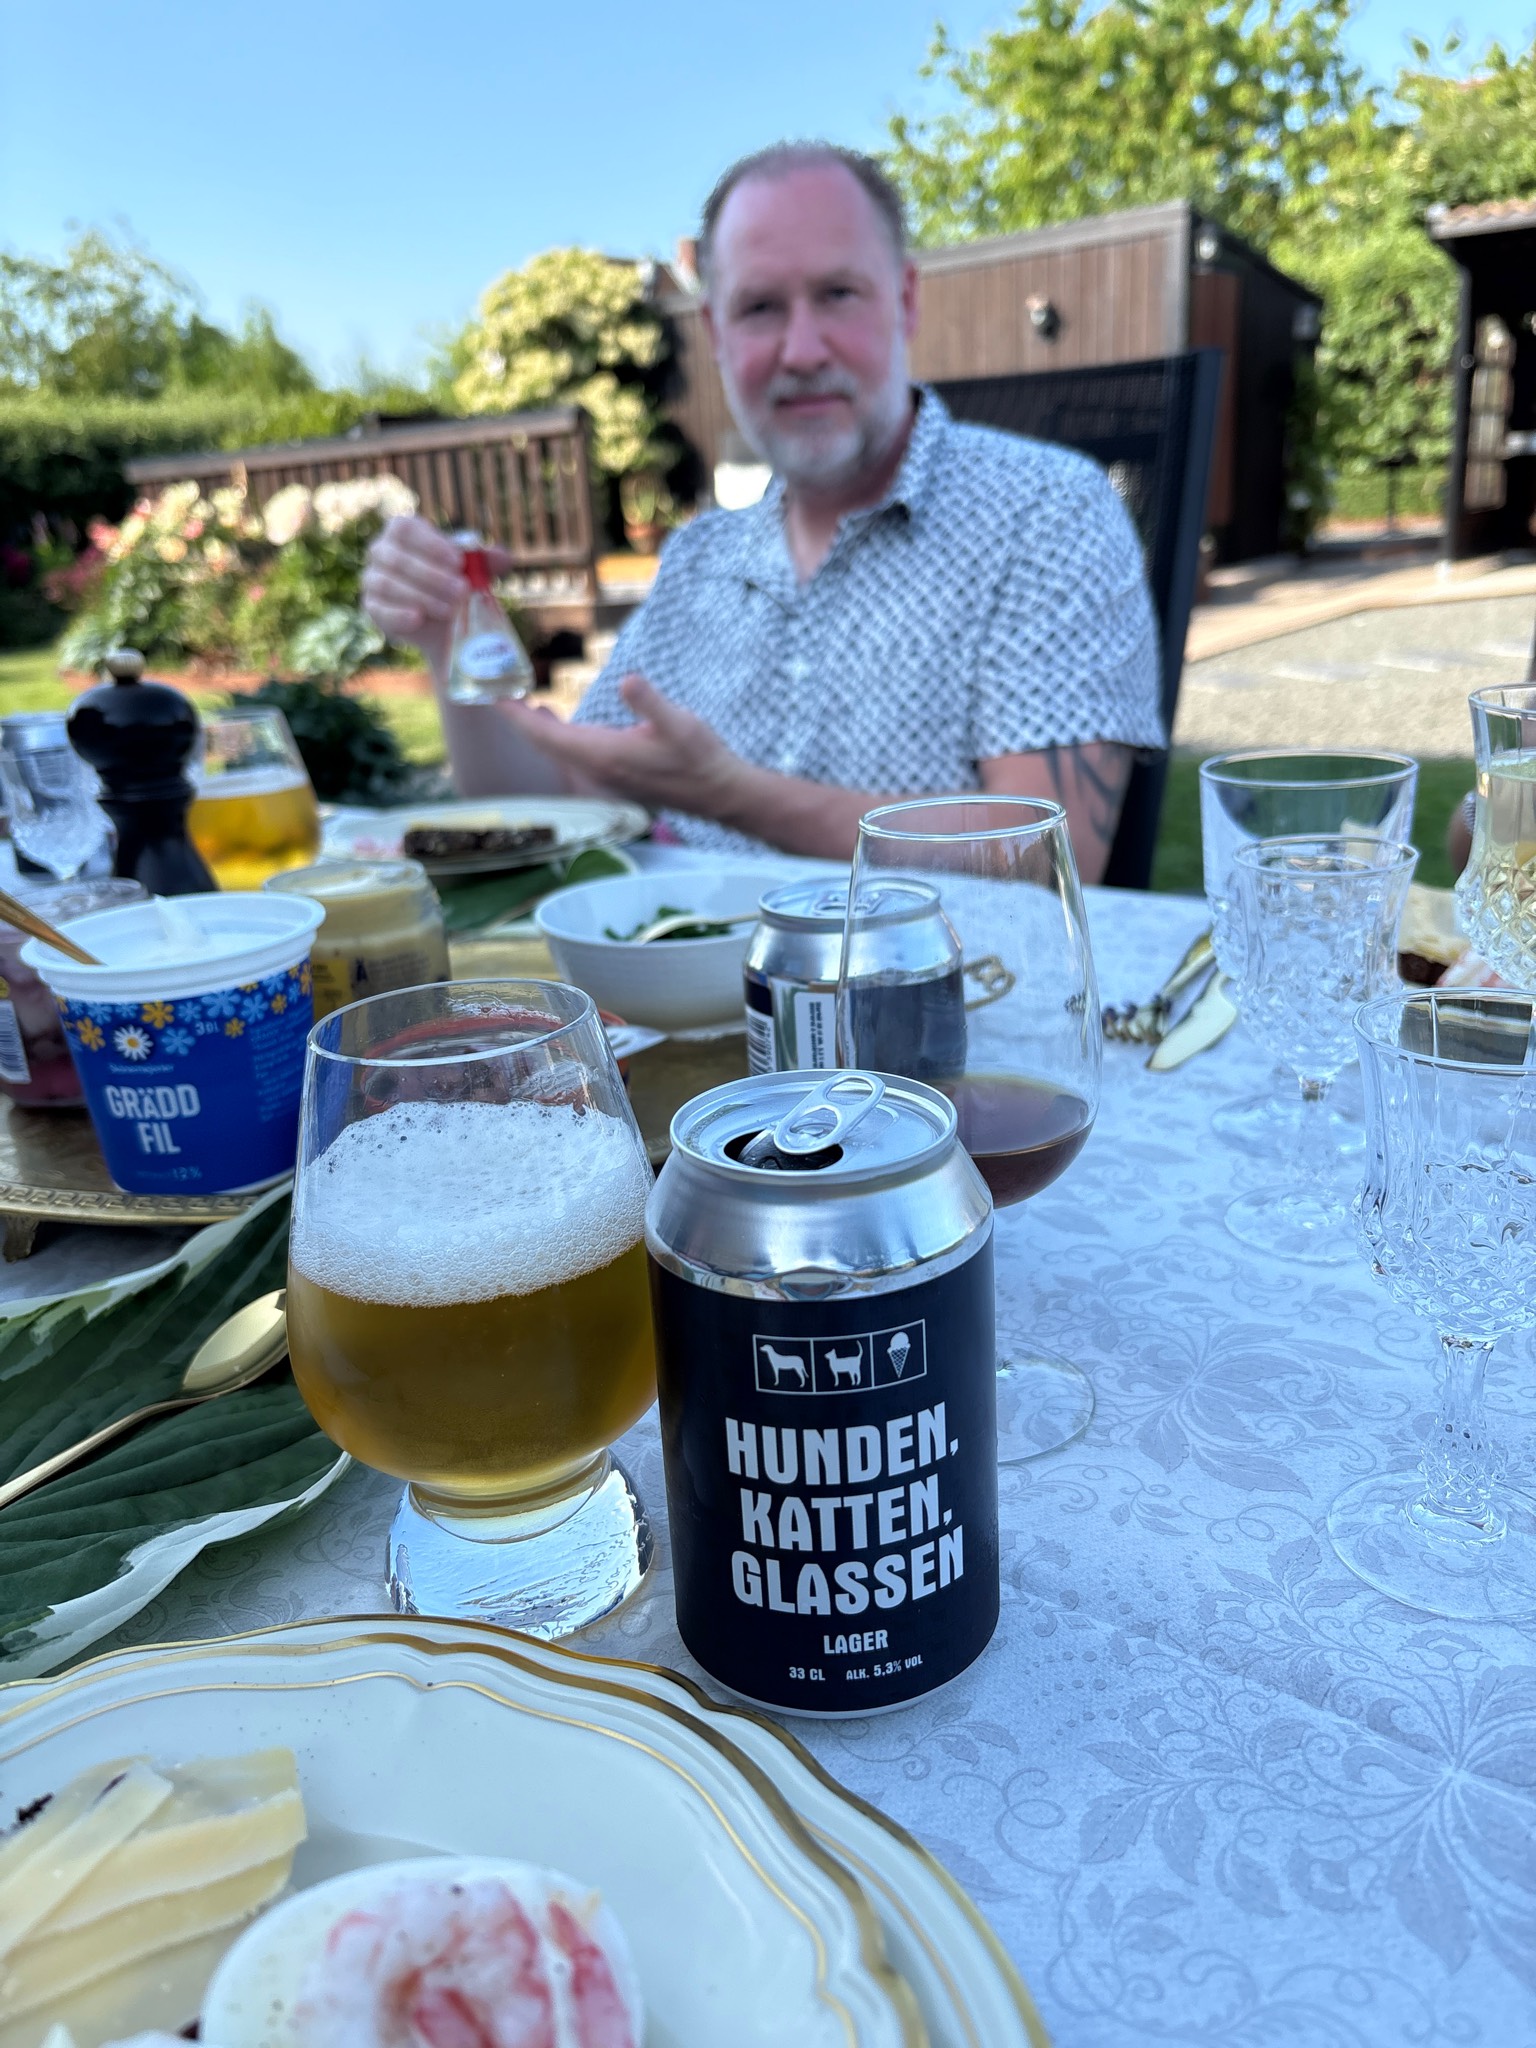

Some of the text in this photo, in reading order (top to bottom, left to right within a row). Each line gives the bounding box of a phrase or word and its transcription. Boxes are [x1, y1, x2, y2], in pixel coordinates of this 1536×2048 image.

[105, 1083, 201, 1120] GRÄDD
[137, 1122, 181, 1155] FIL
[725, 1401, 958, 1485] HUNDEN,
[740, 1474, 952, 1552] KATTEN,
[731, 1525, 964, 1615] GLASSEN
[823, 1629, 889, 1655] LAGER
[788, 1666, 806, 1680] 33
[809, 1668, 826, 1681] CL
[846, 1668, 870, 1681] ALK.
[904, 1654, 924, 1669] VOL
